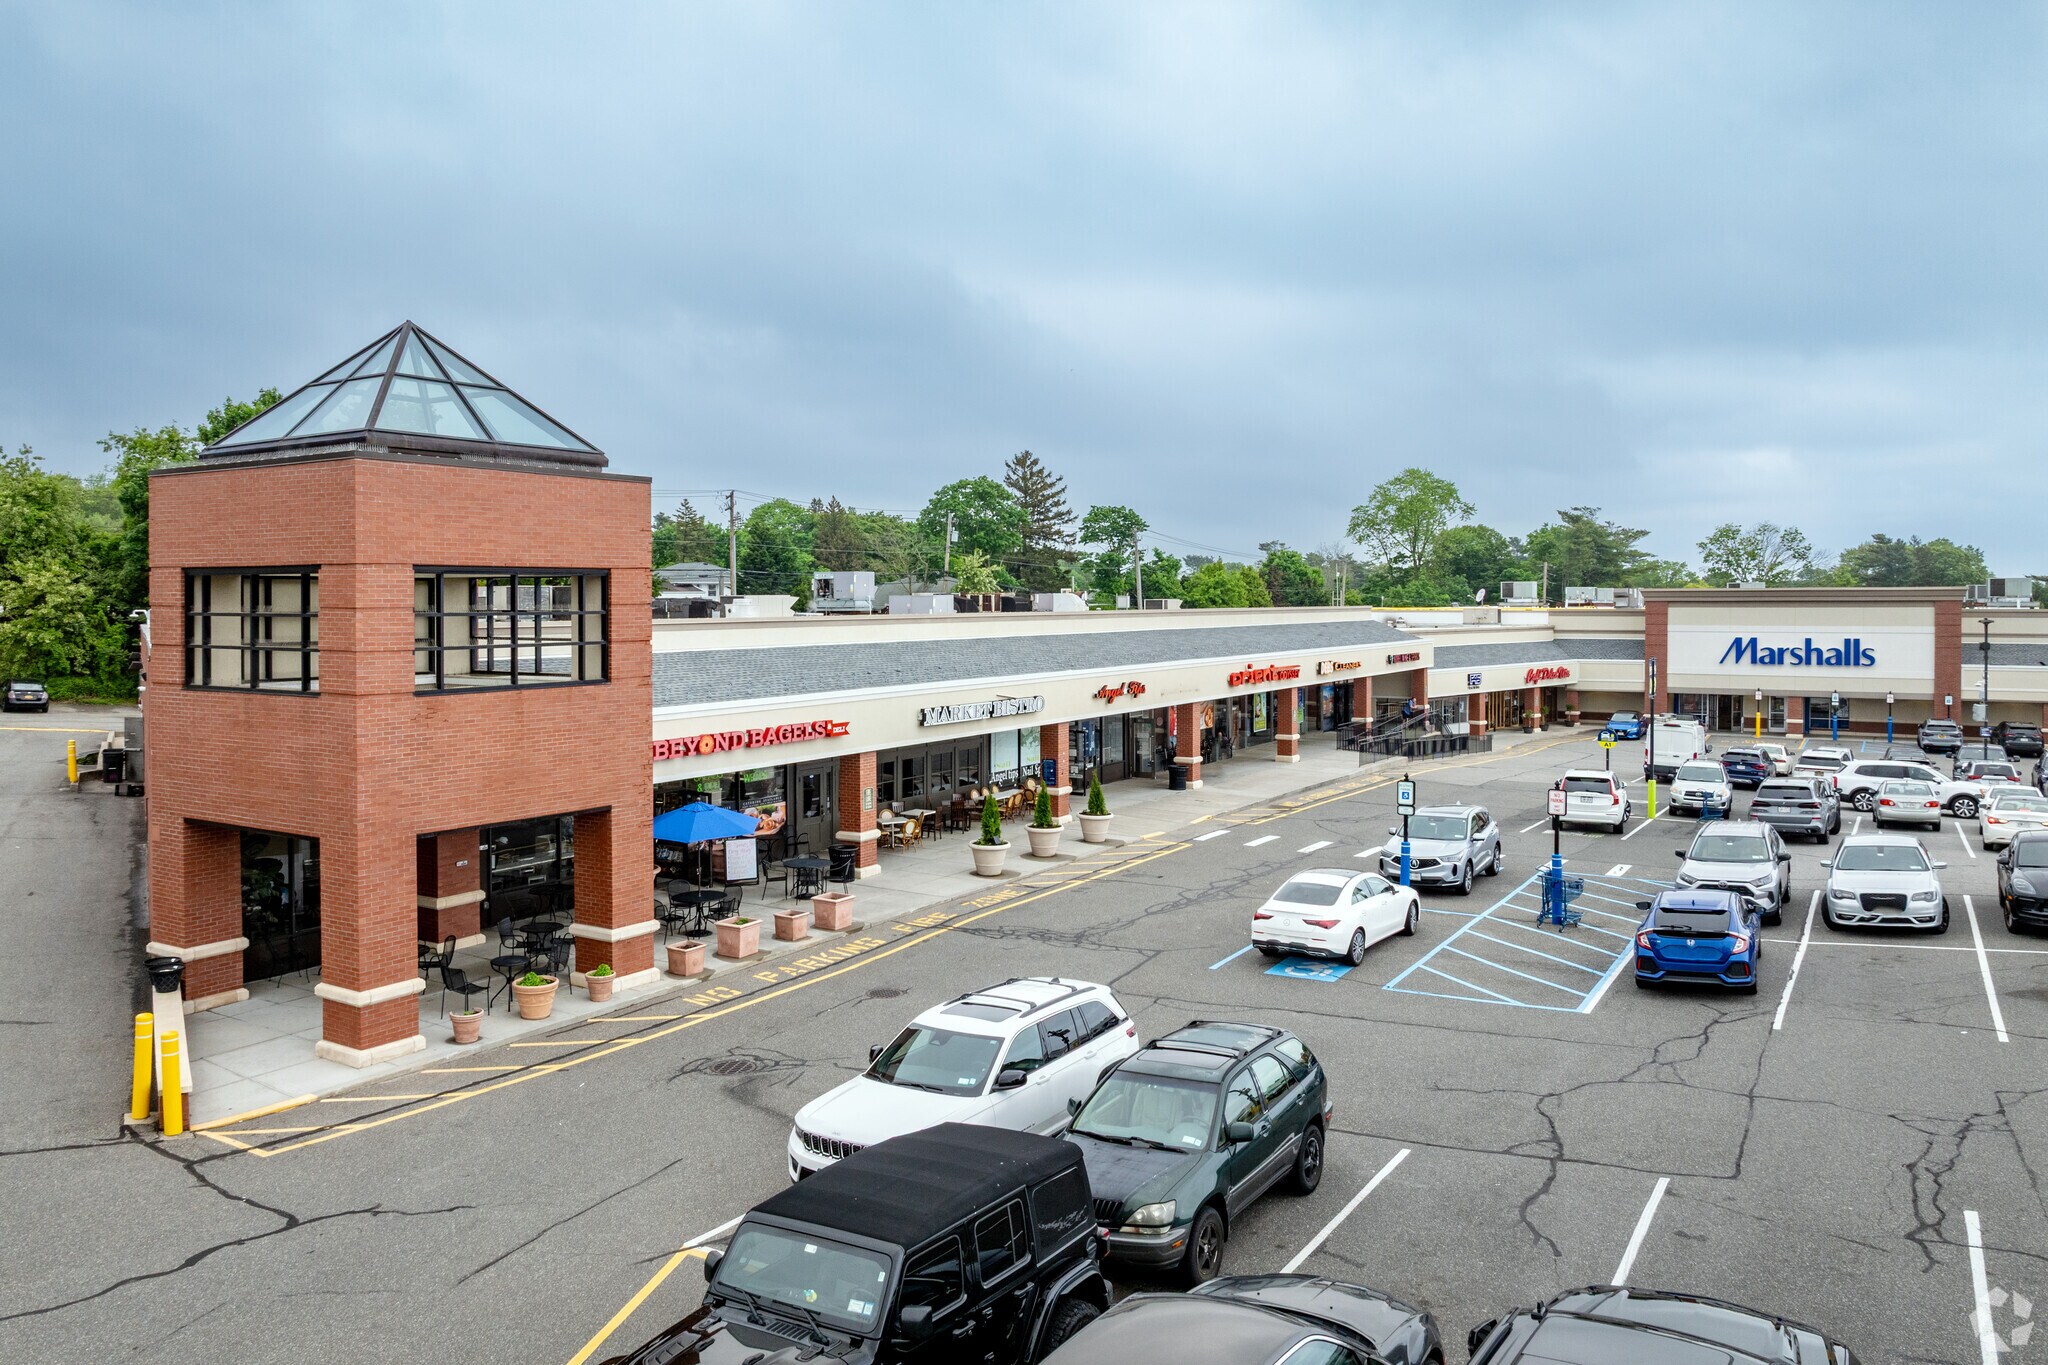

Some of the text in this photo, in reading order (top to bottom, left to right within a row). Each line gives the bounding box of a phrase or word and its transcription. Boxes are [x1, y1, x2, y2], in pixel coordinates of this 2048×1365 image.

[1719, 637, 1875, 666] Marshalls
[1096, 682, 1126, 704] Angel
[922, 695, 1045, 727] MARKET BISTRO
[653, 720, 827, 760] BEYOND BAGELS
[1022, 765, 1034, 777] Nail
[682, 888, 1029, 1007] NO PARKING FIRE ZONE
